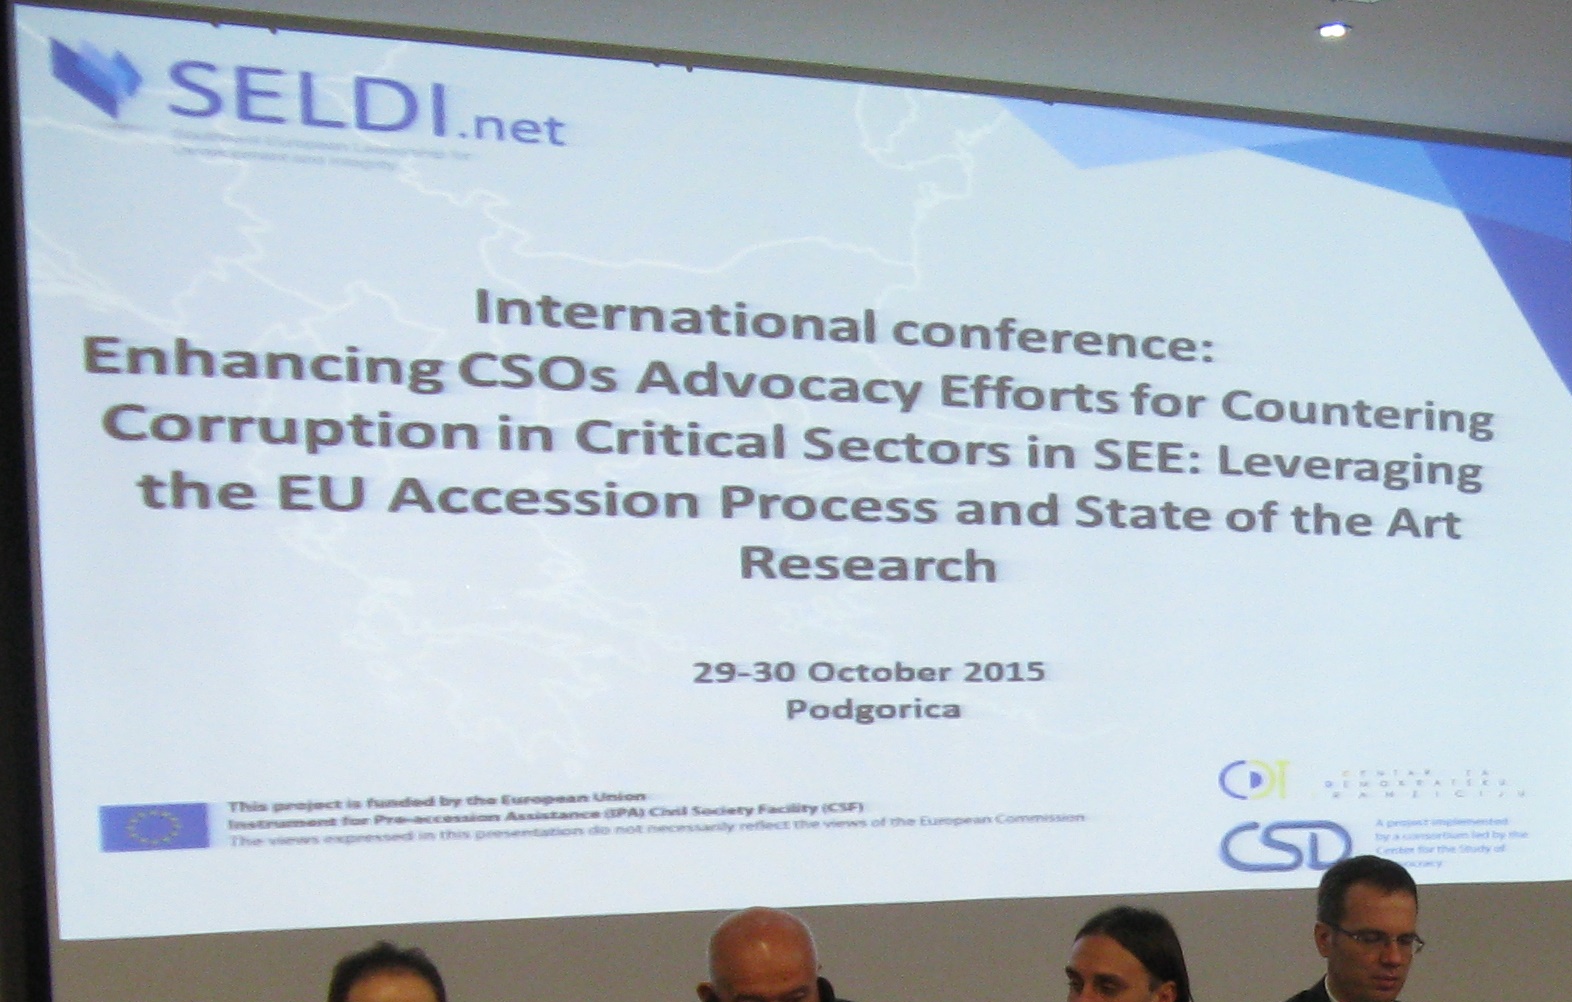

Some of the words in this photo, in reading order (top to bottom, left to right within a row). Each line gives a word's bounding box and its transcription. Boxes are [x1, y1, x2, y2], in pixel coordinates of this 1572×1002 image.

[476, 287, 875, 344] International
[892, 317, 1214, 363] conference:
[83, 335, 446, 395] Enhancing
[458, 351, 618, 393] CSOs
[636, 360, 923, 412] Advocacy
[941, 374, 1119, 415] Efforts
[1131, 382, 1206, 418] for
[1221, 389, 1495, 442] Countering
[102, 402, 480, 454] Corruption
[497, 414, 554, 452] in
[576, 419, 785, 459] Critical
[803, 427, 1010, 467] Sectors
[1027, 434, 1075, 470] in
[1094, 438, 1201, 474] SEE:
[1218, 444, 1483, 494] Leveraging
[136, 470, 257, 510] the
[278, 474, 365, 511] EU
[387, 477, 699, 518] Accession
[721, 485, 938, 521] Process
[956, 493, 1059, 526] and
[1075, 495, 1211, 531] State
[1225, 500, 1279, 533] of
[1291, 503, 1373, 537] the
[1386, 507, 1462, 539] Art
[740, 545, 997, 583] Research
[692, 661, 796, 684] 29-30
[808, 661, 951, 682] October
[963, 661, 1046, 682] 2015
[786, 698, 962, 725] Podgorica
[229, 801, 267, 813] This
[272, 799, 341, 814] project
[367, 796, 435, 809] funded
[440, 796, 460, 809] by
[466, 795, 496, 806] the
[502, 793, 588, 806] European
[593, 791, 646, 802] Union
[342, 815, 369, 826] for
[506, 808, 600, 822] Assistance
[650, 804, 687, 817] Civil
[692, 803, 754, 817] Society
[758, 802, 818, 816] Facility
